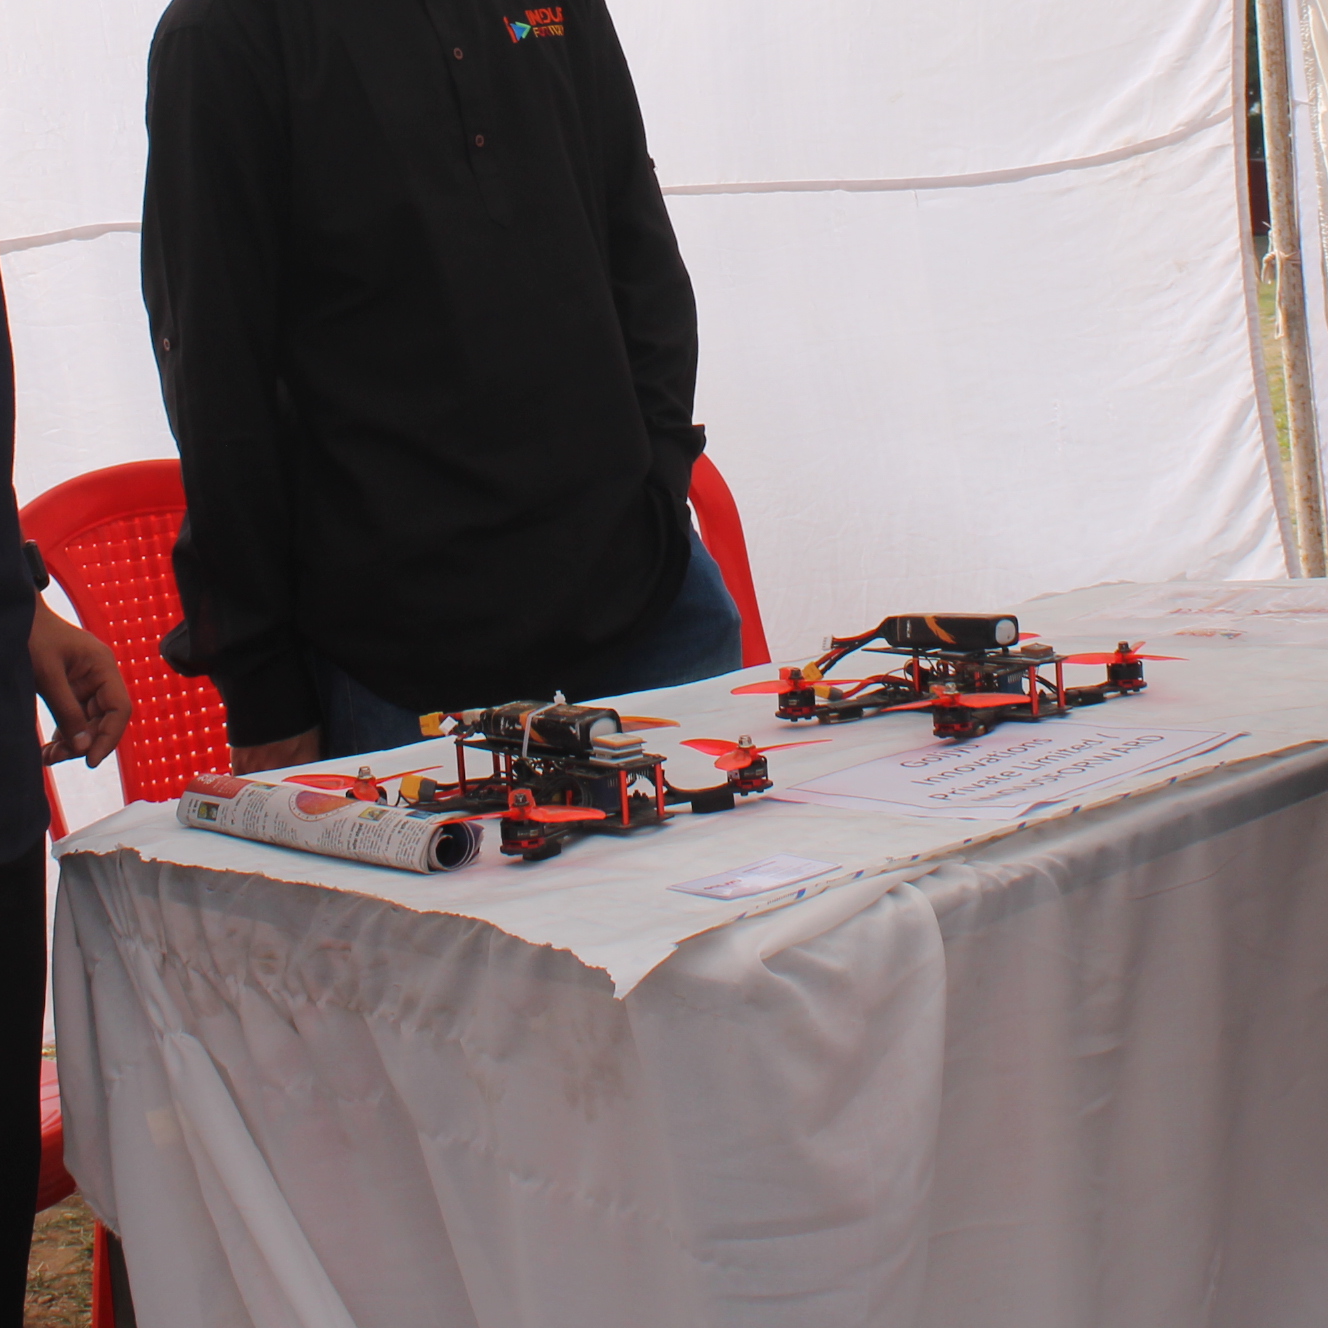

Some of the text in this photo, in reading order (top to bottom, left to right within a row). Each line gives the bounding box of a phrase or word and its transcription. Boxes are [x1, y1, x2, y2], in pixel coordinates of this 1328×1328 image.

[911, 738, 1053, 786] Innovations
[928, 770, 1023, 800] Private
[1011, 738, 1105, 770] Limited
